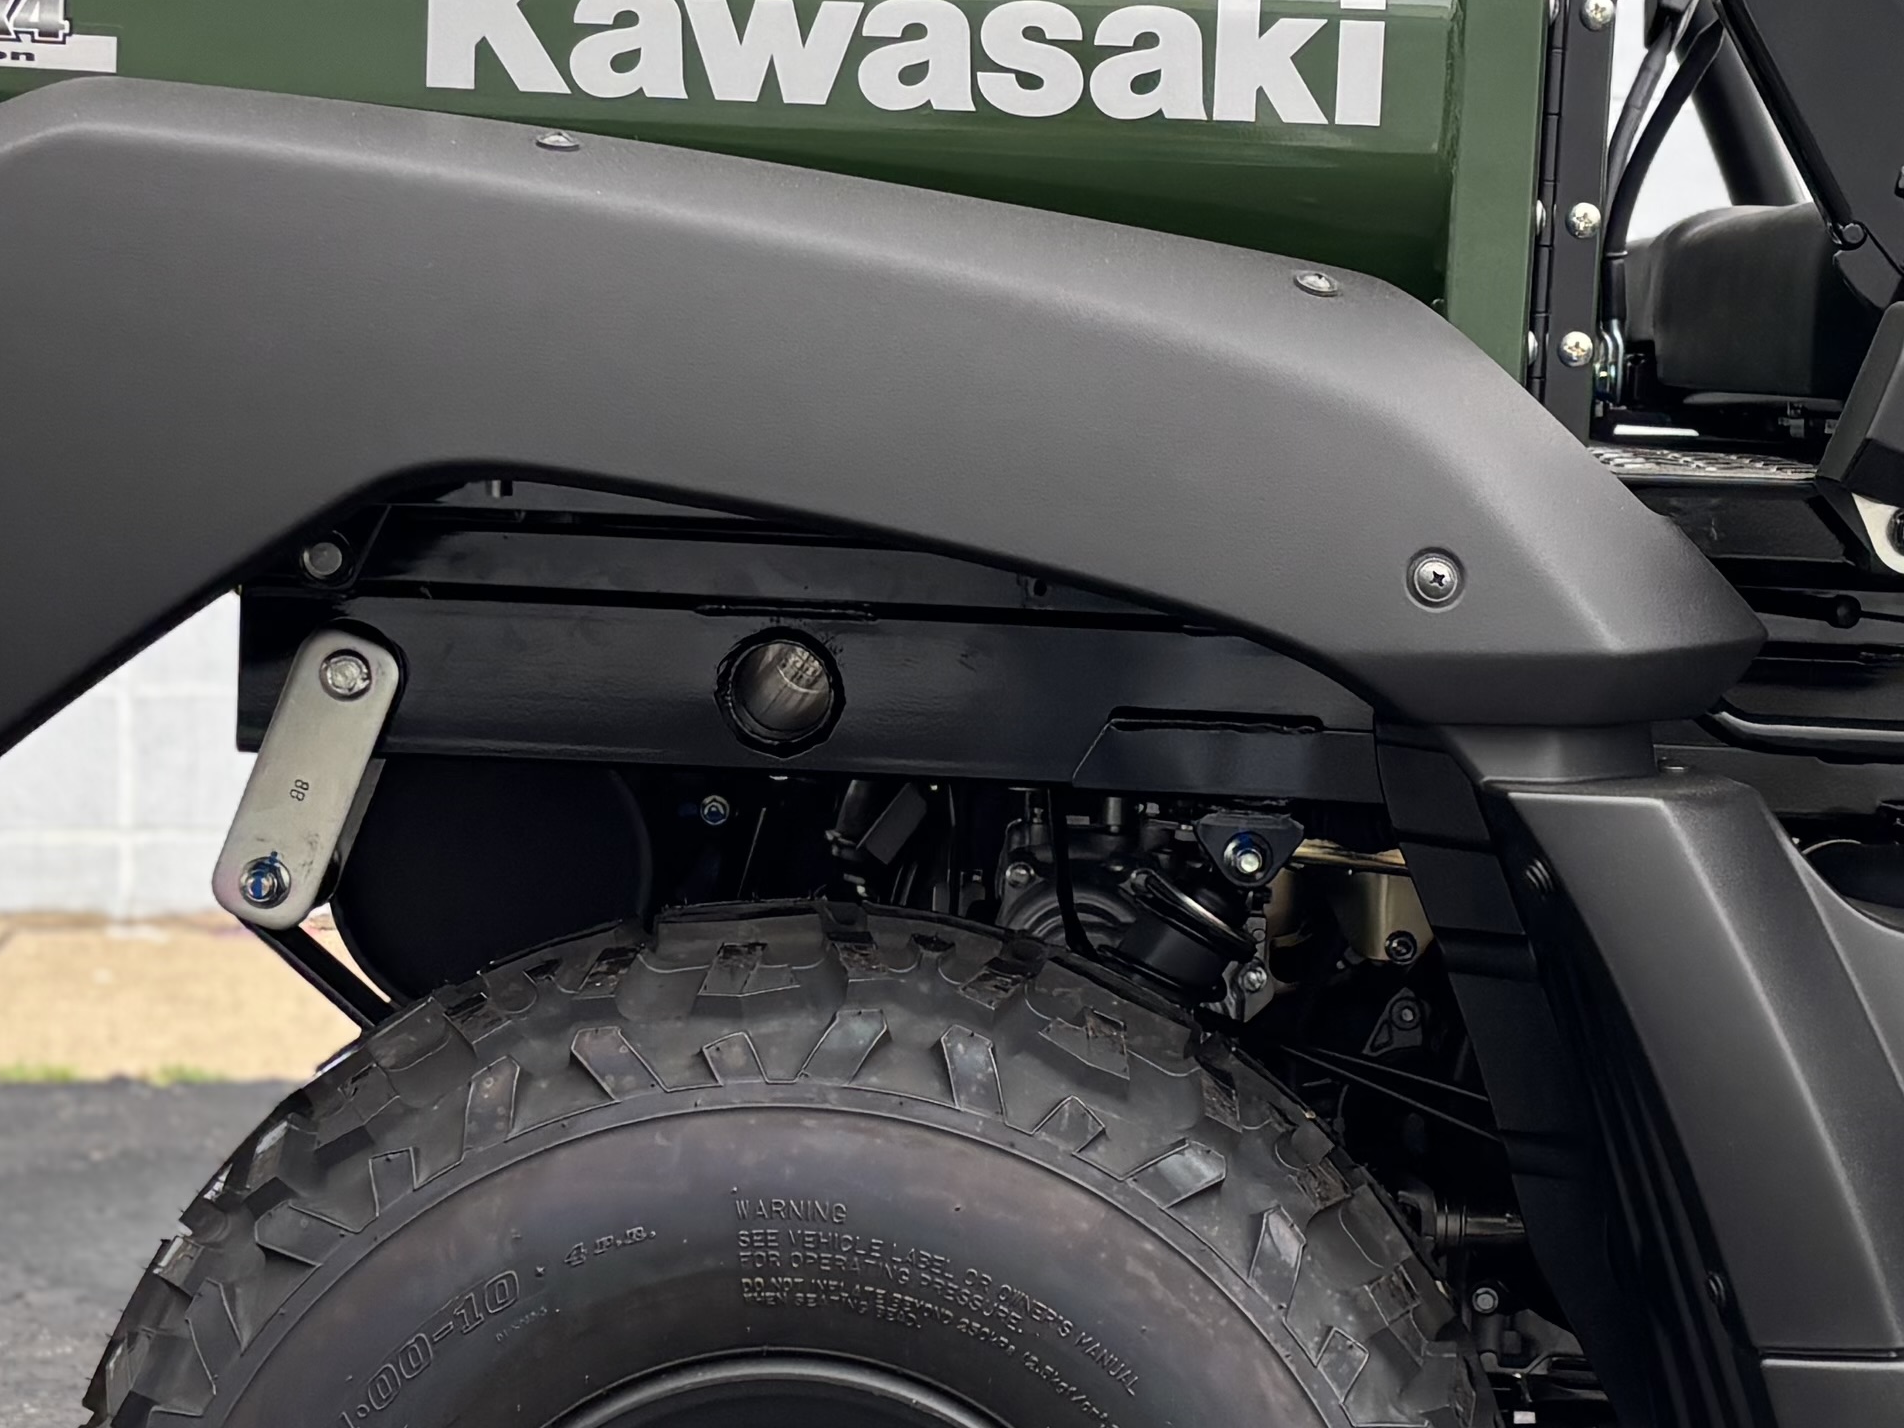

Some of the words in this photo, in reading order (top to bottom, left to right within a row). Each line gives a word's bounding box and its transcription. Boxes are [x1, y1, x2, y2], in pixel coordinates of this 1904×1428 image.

[735, 1199, 848, 1224] WARNING
[739, 1250, 781, 1269] FOR
[790, 1250, 911, 1285] OPERATING
[770, 1276, 804, 1293] NOT
[810, 1277, 887, 1305] INFLATE
[738, 1229, 780, 1248] SEE
[788, 1229, 884, 1258] VEHICLE
[892, 1241, 954, 1279] LABEL
[964, 1267, 993, 1294] OR
[1075, 1330, 1141, 1398] MANUAL
